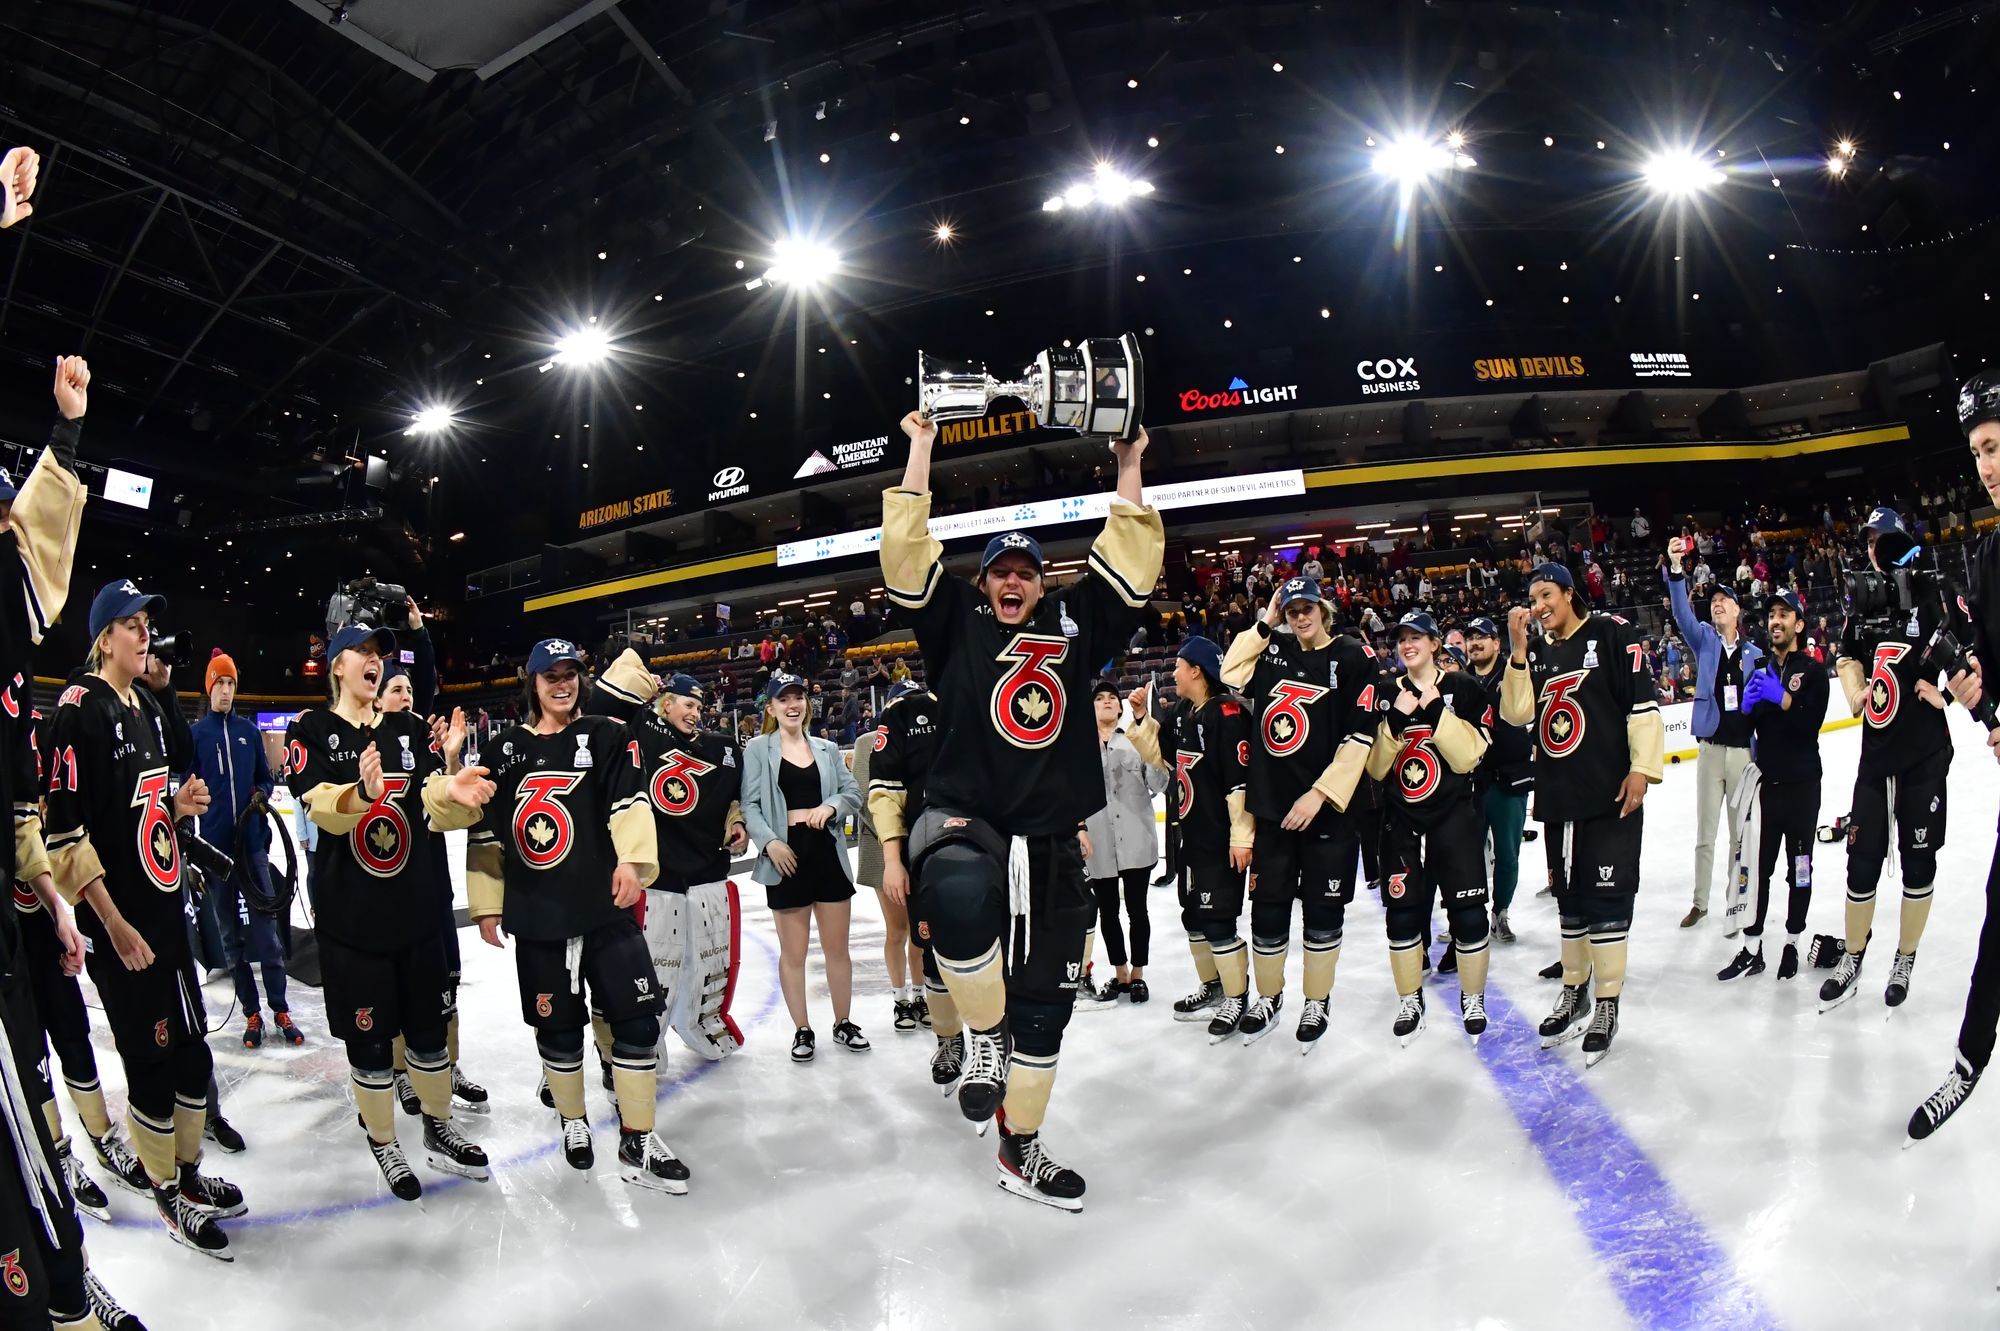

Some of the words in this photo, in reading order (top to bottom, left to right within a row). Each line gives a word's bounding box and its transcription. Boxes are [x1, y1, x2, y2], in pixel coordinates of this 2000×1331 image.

[1630, 352, 1656, 363] GILA
[1655, 353, 1687, 363] RIVER
[1357, 357, 1418, 381] COX
[1473, 358, 1518, 381] SUN
[1519, 355, 1585, 379] DEVILS
[1362, 380, 1420, 395] BUSINESS
[1179, 388, 1242, 411] Coors
[1242, 385, 1298, 405] LIGHT
[941, 410, 1037, 446] MULLETT
[832, 436, 889, 456] MOUNTAIN
[836, 447, 884, 465] AMERICA
[841, 460, 861, 469] CREDIT
[862, 457, 880, 466] UNION
[708, 484, 750, 502] HYUNDAI
[1152, 492, 1177, 502] PROUD
[1177, 488, 1210, 499] PARTNER
[1210, 487, 1219, 495] OF
[1221, 486, 1236, 494] SUN
[1237, 483, 1257, 492] DEVIL
[1258, 479, 1296, 490] ATHLETICS
[578, 500, 632, 529] ARIZONA
[632, 488, 674, 515] STATE
[953, 519, 982, 530] MULLETT
[983, 516, 1006, 526] ARENA
[1626, 643, 1643, 673] 7
[49, 744, 78, 793] 21
[1456, 886, 1486, 899] CCM
[700, 943, 729, 961] VAUGHN
[653, 957, 681, 969] UGHN
